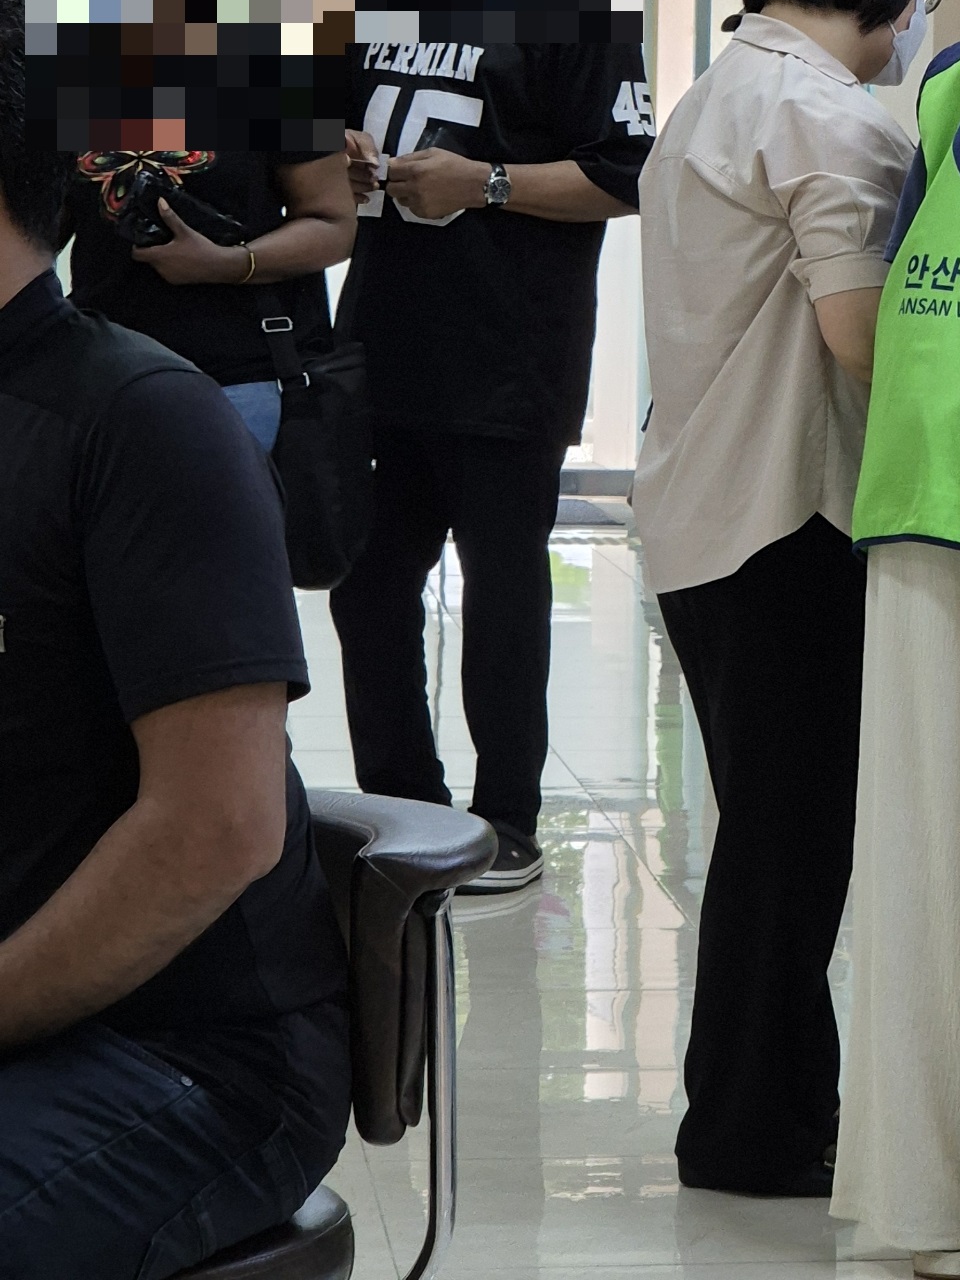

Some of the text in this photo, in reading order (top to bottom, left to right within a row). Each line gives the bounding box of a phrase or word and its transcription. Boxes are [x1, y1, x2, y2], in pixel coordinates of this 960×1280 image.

[363, 43, 485, 82] PERMIAN
[612, 81, 657, 137] 45
[899, 297, 953, 317] ANSAN
